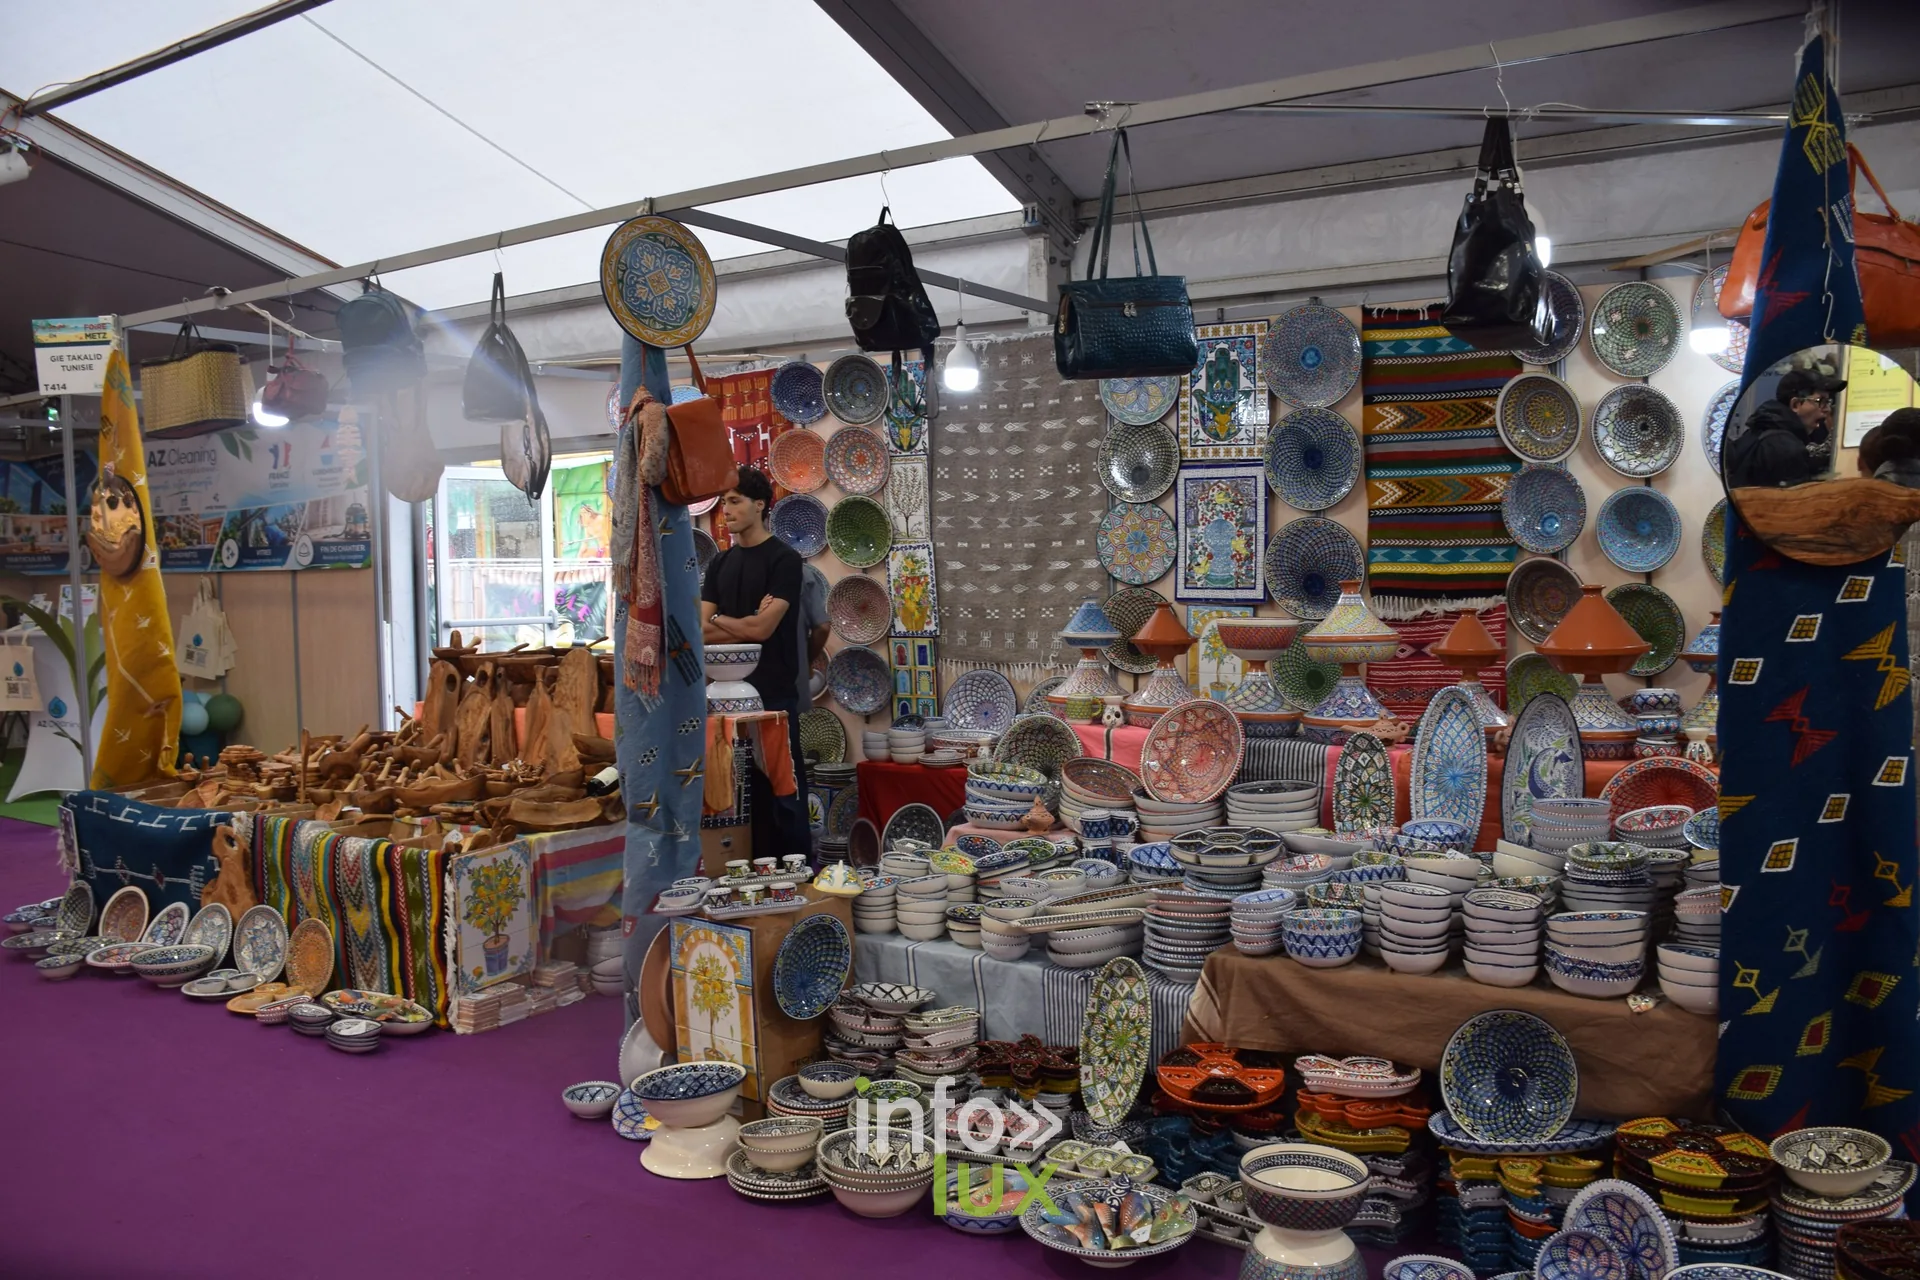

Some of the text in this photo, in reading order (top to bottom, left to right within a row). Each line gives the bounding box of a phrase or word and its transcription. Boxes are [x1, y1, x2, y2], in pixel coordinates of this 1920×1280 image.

[84, 332, 108, 340] METZ
[50, 353, 103, 363] GIE TAKALID
[61, 363, 94, 372] TUNISIE
[44, 383, 67, 392] T414
[147, 446, 217, 468] AZ Cleaning
